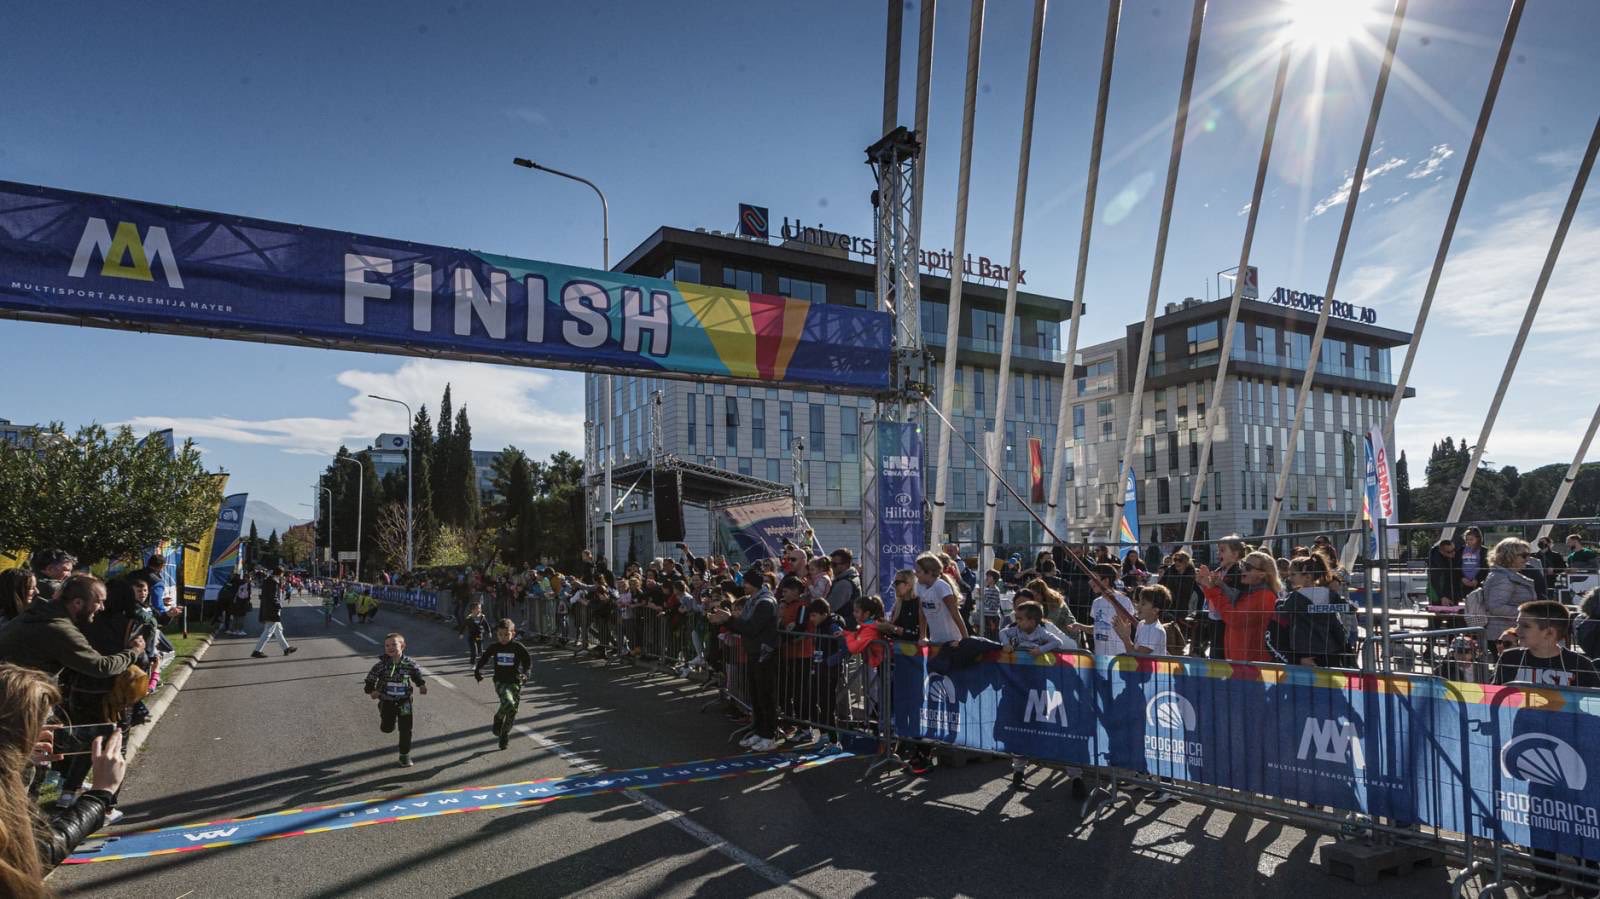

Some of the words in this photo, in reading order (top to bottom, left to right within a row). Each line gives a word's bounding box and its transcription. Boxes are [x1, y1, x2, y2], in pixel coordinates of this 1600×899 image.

[11, 281, 104, 299] MULTISPORT
[108, 293, 187, 309] AKADEMIJA
[190, 302, 233, 313] MAYER
[343, 253, 672, 357] FINISH
[1272, 286, 1358, 320] JUGOPEROL
[1360, 306, 1377, 324] AD
[885, 506, 921, 519] Hilton
[1144, 735, 1203, 757] PODGORICA
[1494, 789, 1599, 827] PODGORICA
